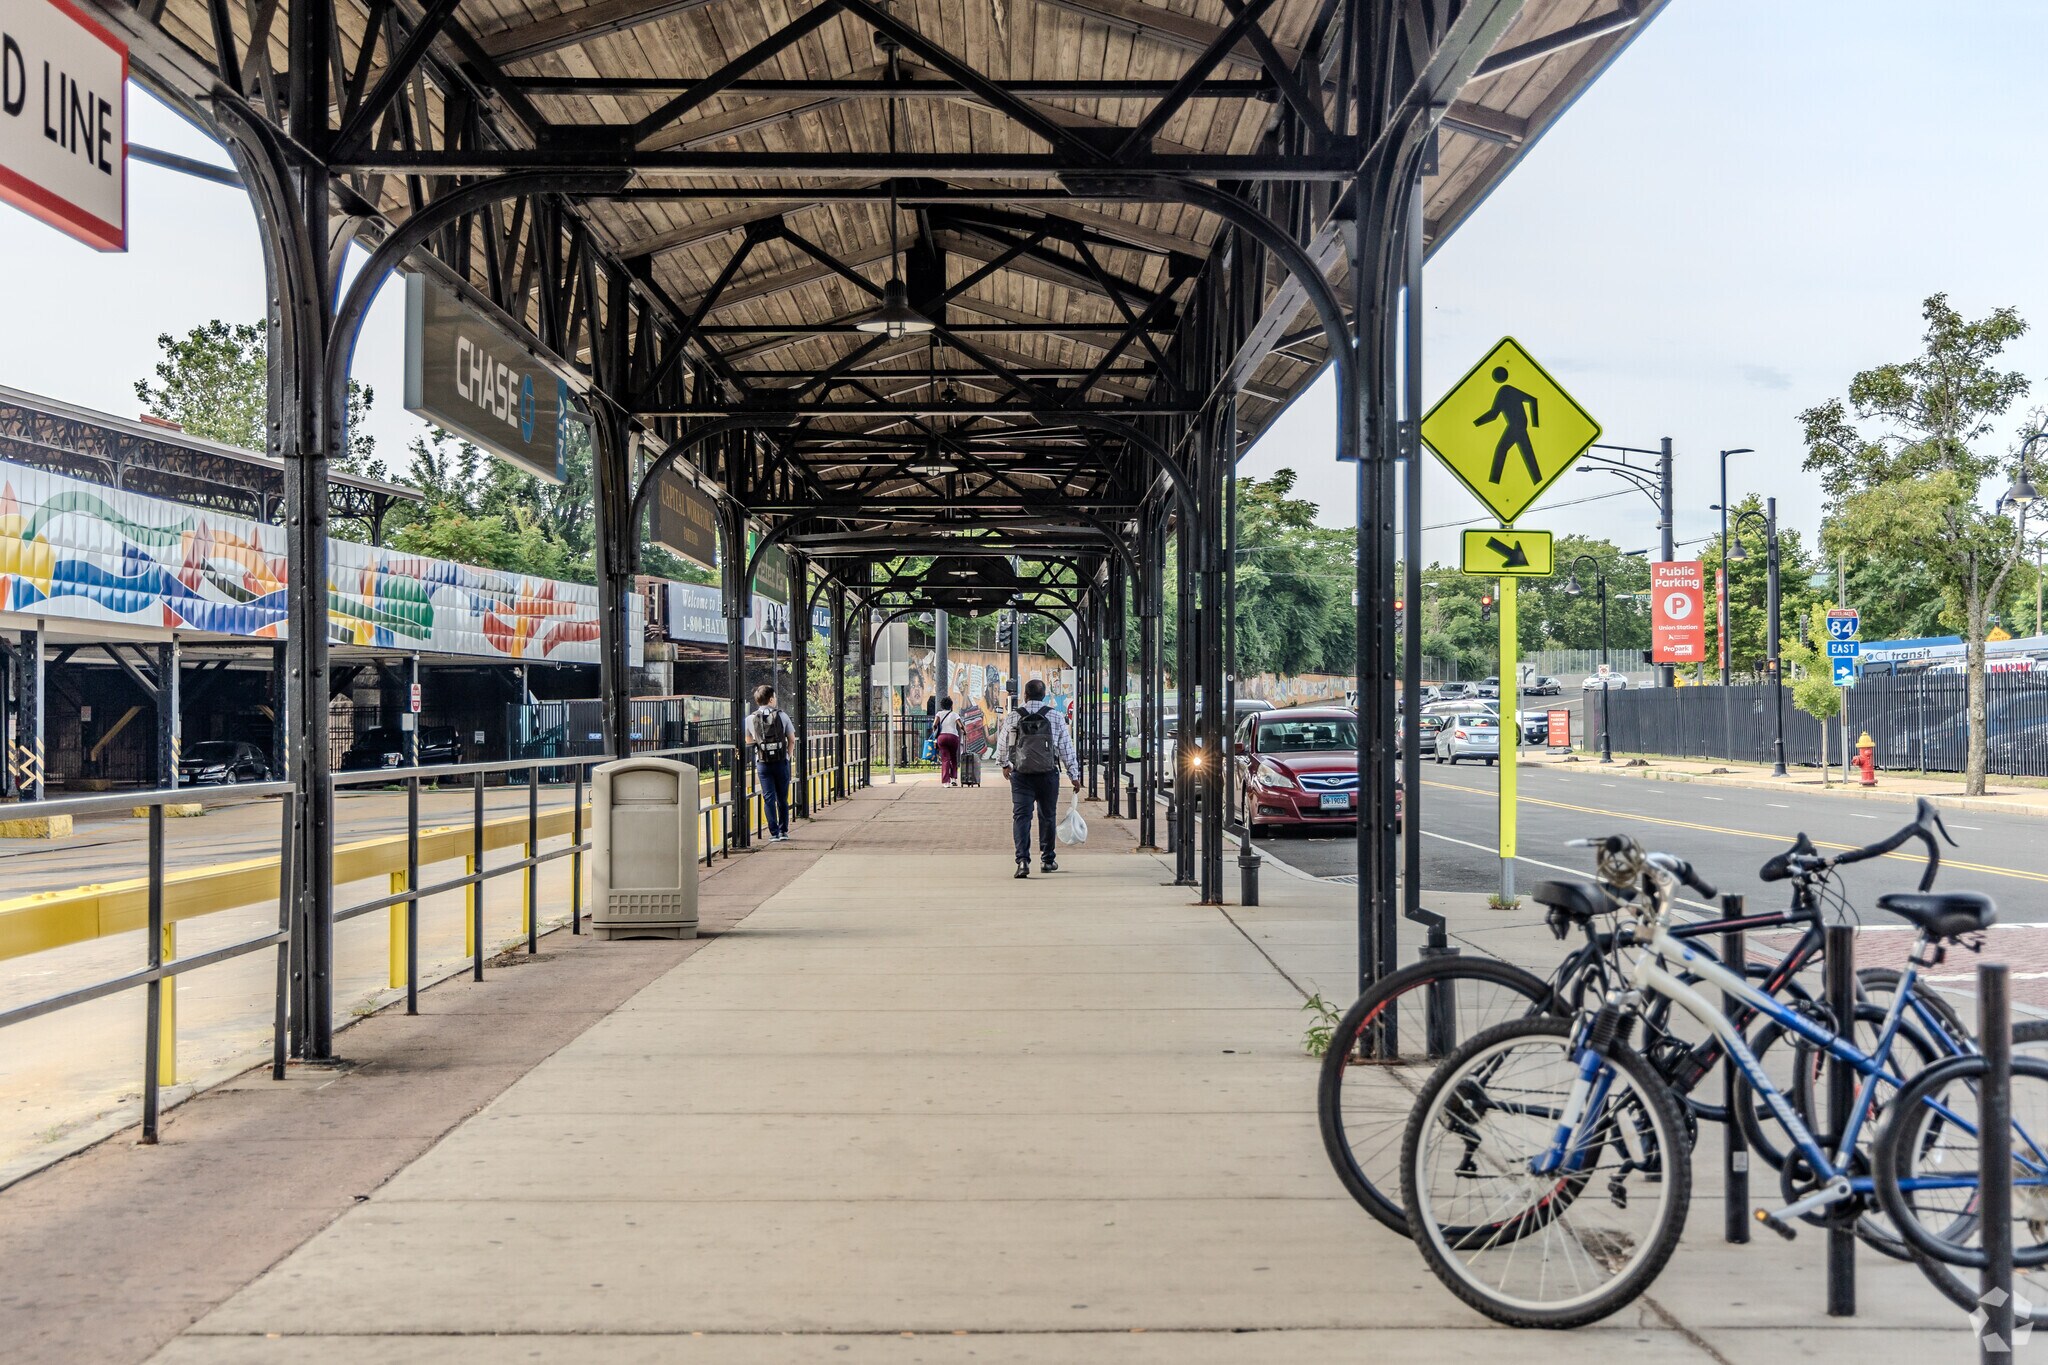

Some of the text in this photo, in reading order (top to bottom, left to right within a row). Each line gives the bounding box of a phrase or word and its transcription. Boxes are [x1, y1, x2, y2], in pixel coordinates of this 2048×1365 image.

[44, 60, 112, 176] LINE
[456, 335, 520, 429] CHASE
[557, 396, 566, 466] ATM
[1659, 566, 1695, 577] Public
[1655, 577, 1700, 589] Parking
[682, 589, 708, 610] Welcome
[709, 597, 715, 611] to
[683, 616, 728, 636] 1-800-HAYM
[1830, 621, 1854, 636] 84
[1831, 644, 1855, 654] EAST
[1875, 648, 1931, 661] CT transit
